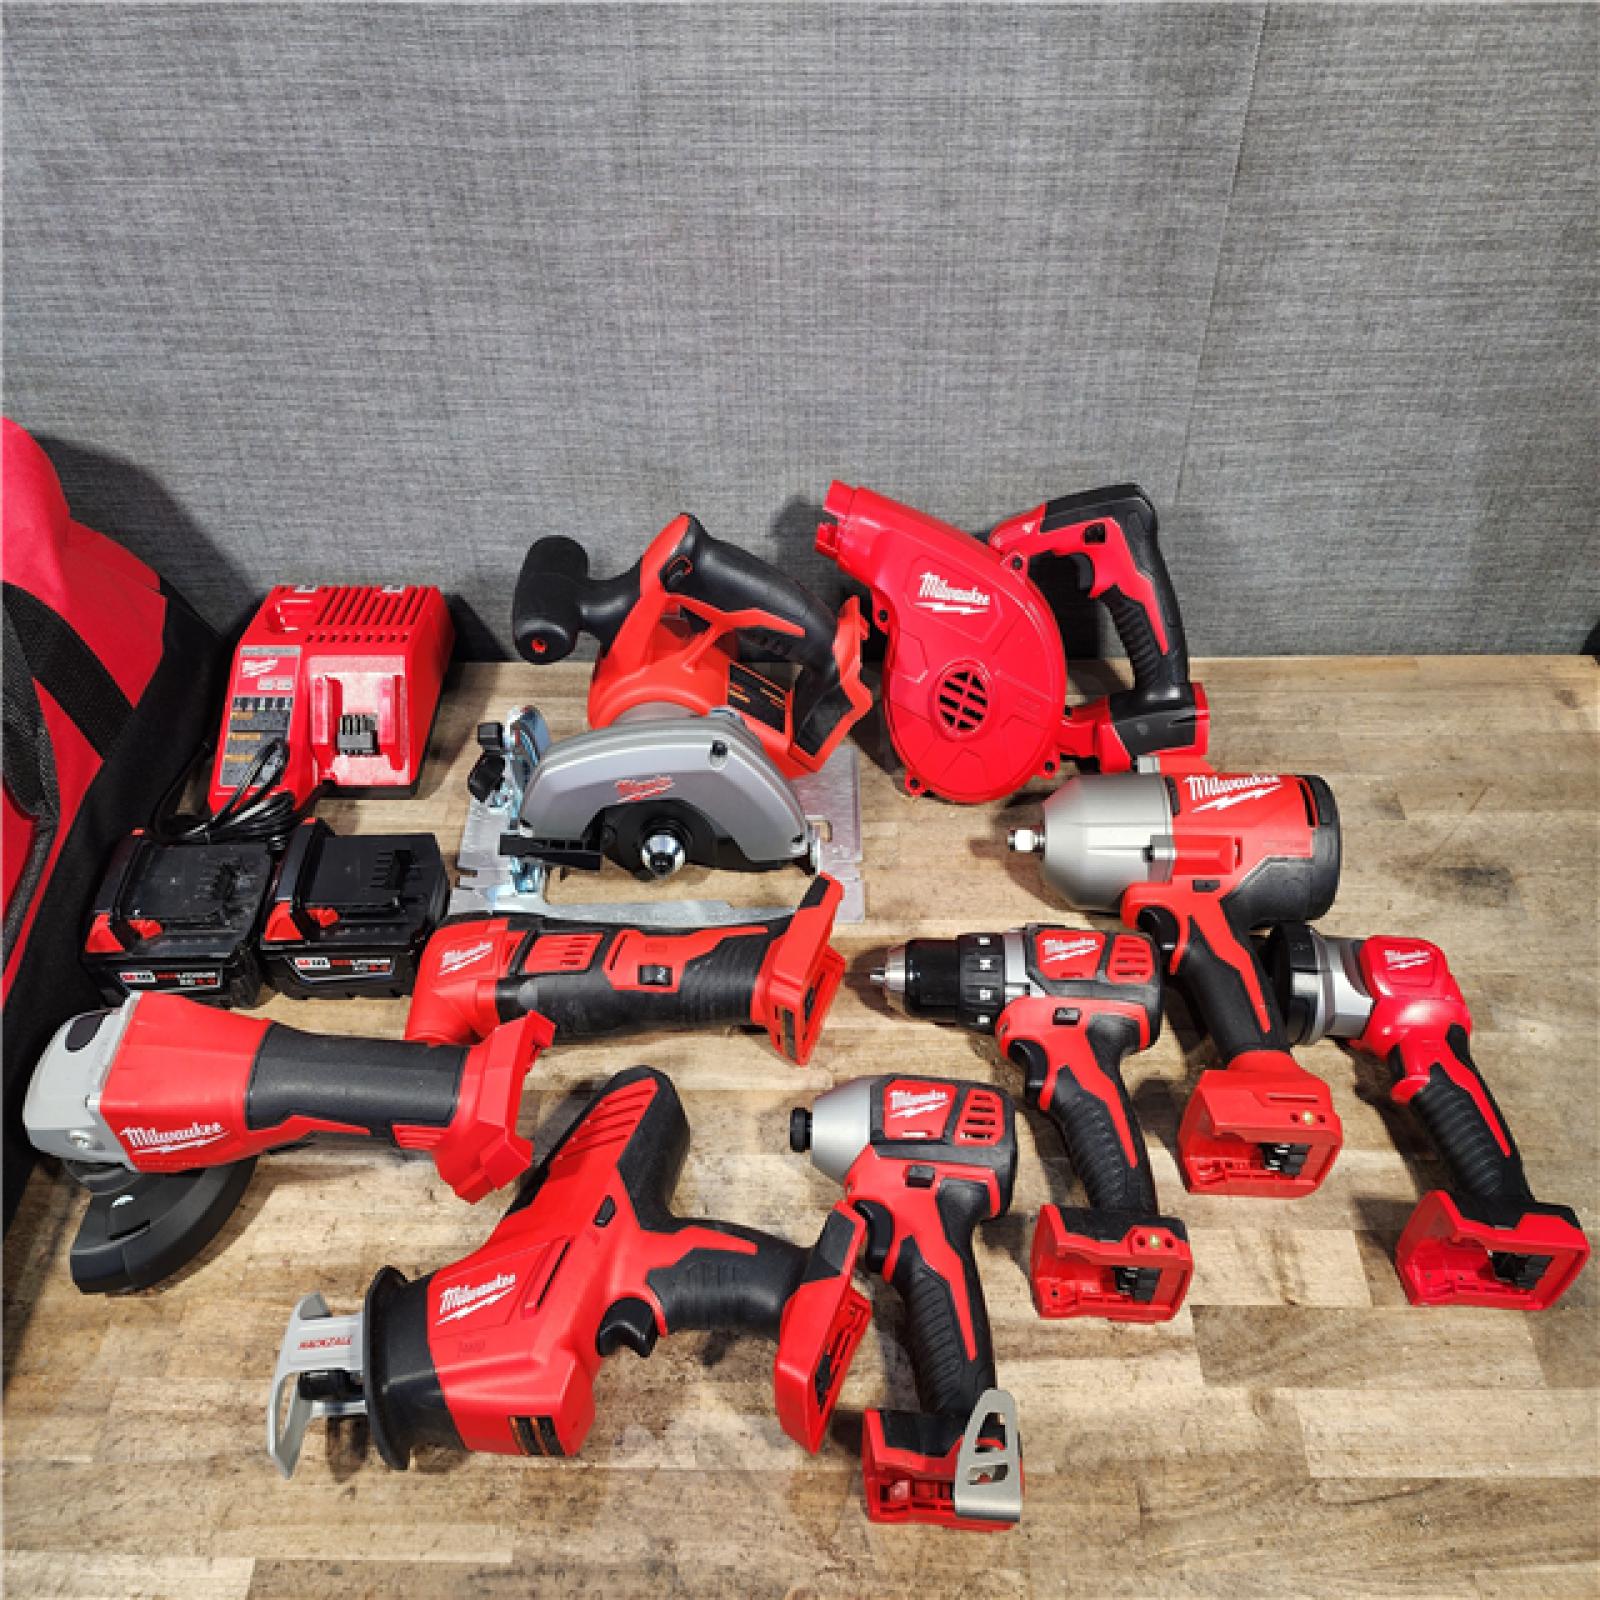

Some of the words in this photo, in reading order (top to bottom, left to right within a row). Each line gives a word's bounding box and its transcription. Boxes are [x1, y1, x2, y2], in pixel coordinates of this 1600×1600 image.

[1183, 773, 1281, 800] Milwaukee
[119, 1122, 223, 1148] Milwaukee
[439, 1273, 516, 1315] Milwaukee
